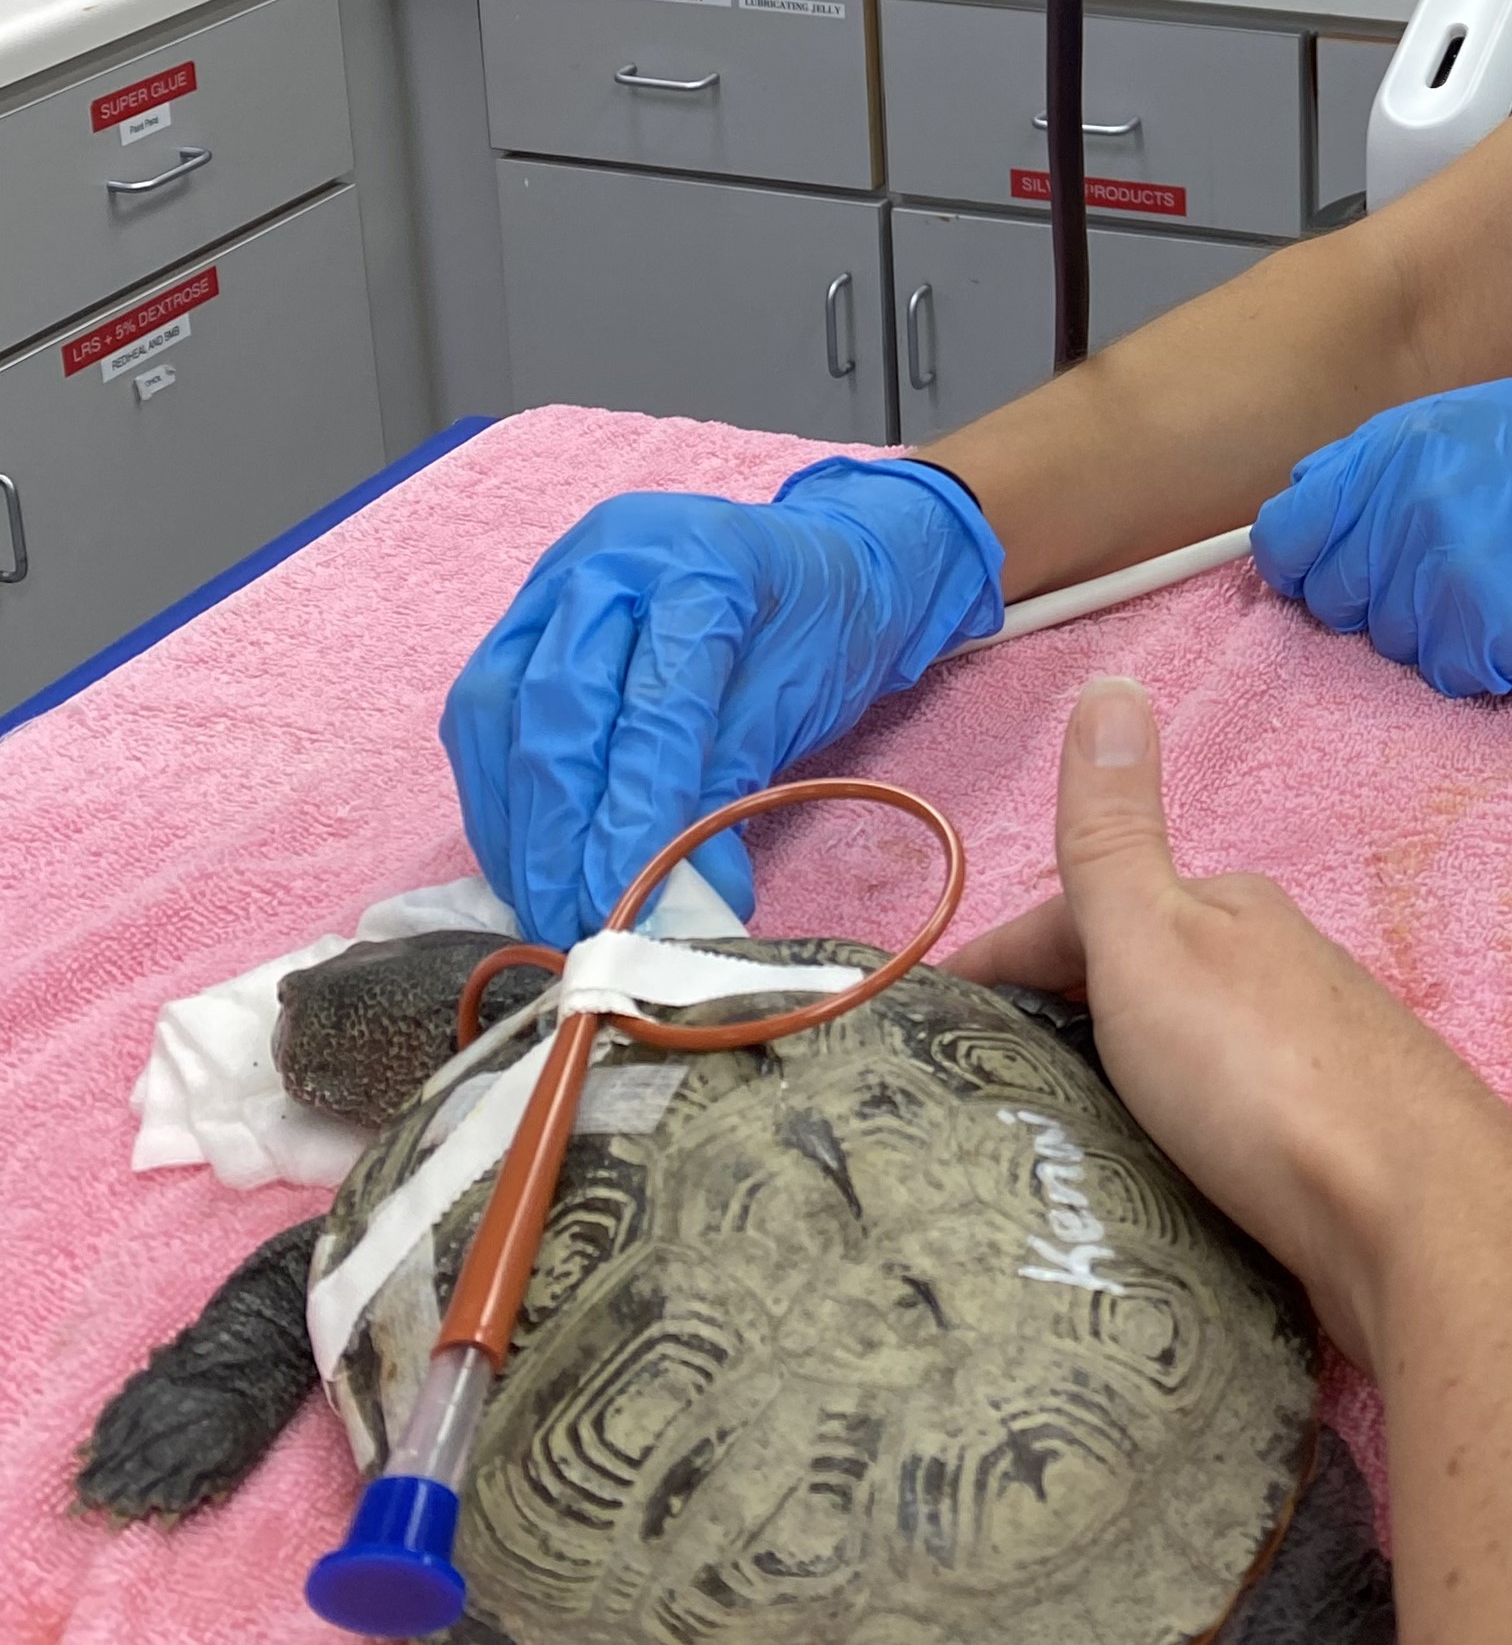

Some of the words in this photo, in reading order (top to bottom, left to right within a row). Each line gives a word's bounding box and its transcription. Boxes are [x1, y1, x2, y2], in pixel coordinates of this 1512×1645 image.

[811, 4, 842, 16] JELLY
[100, 87, 149, 120] SUPER
[150, 71, 188, 98] GLUE
[72, 335, 102, 363] LRS
[115, 319, 137, 340] 5%
[138, 277, 210, 328] DEXTROSE
[148, 334, 165, 350] AND
